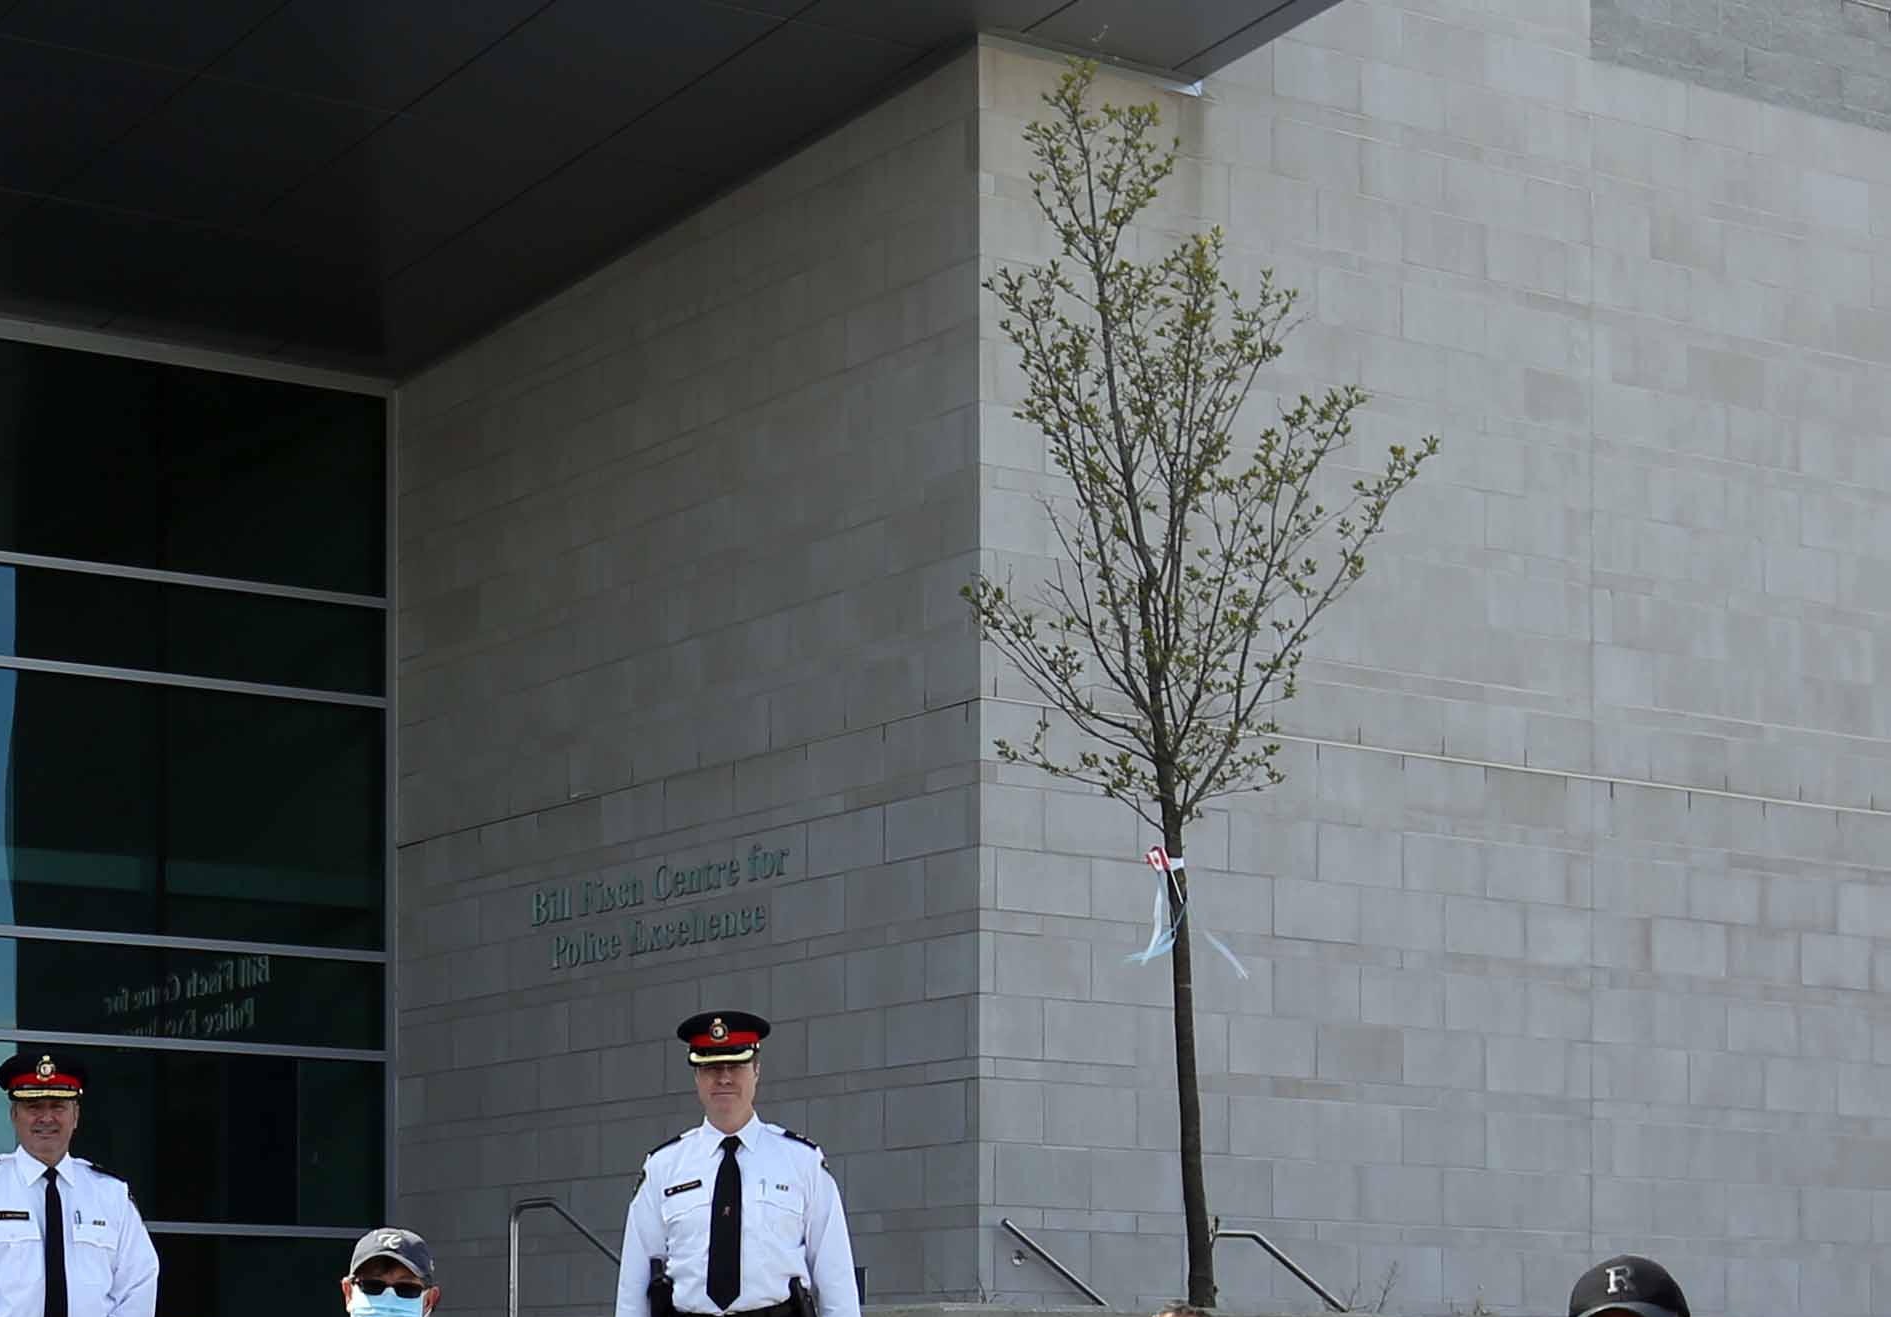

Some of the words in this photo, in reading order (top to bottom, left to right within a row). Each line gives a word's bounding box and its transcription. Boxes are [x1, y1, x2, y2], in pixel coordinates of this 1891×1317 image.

[531, 886, 572, 927] Bill
[653, 857, 740, 901] Centre
[747, 843, 790, 882] for
[550, 931, 621, 970] Police
[628, 903, 768, 957] Excellence
[1605, 1264, 1633, 1294] R
